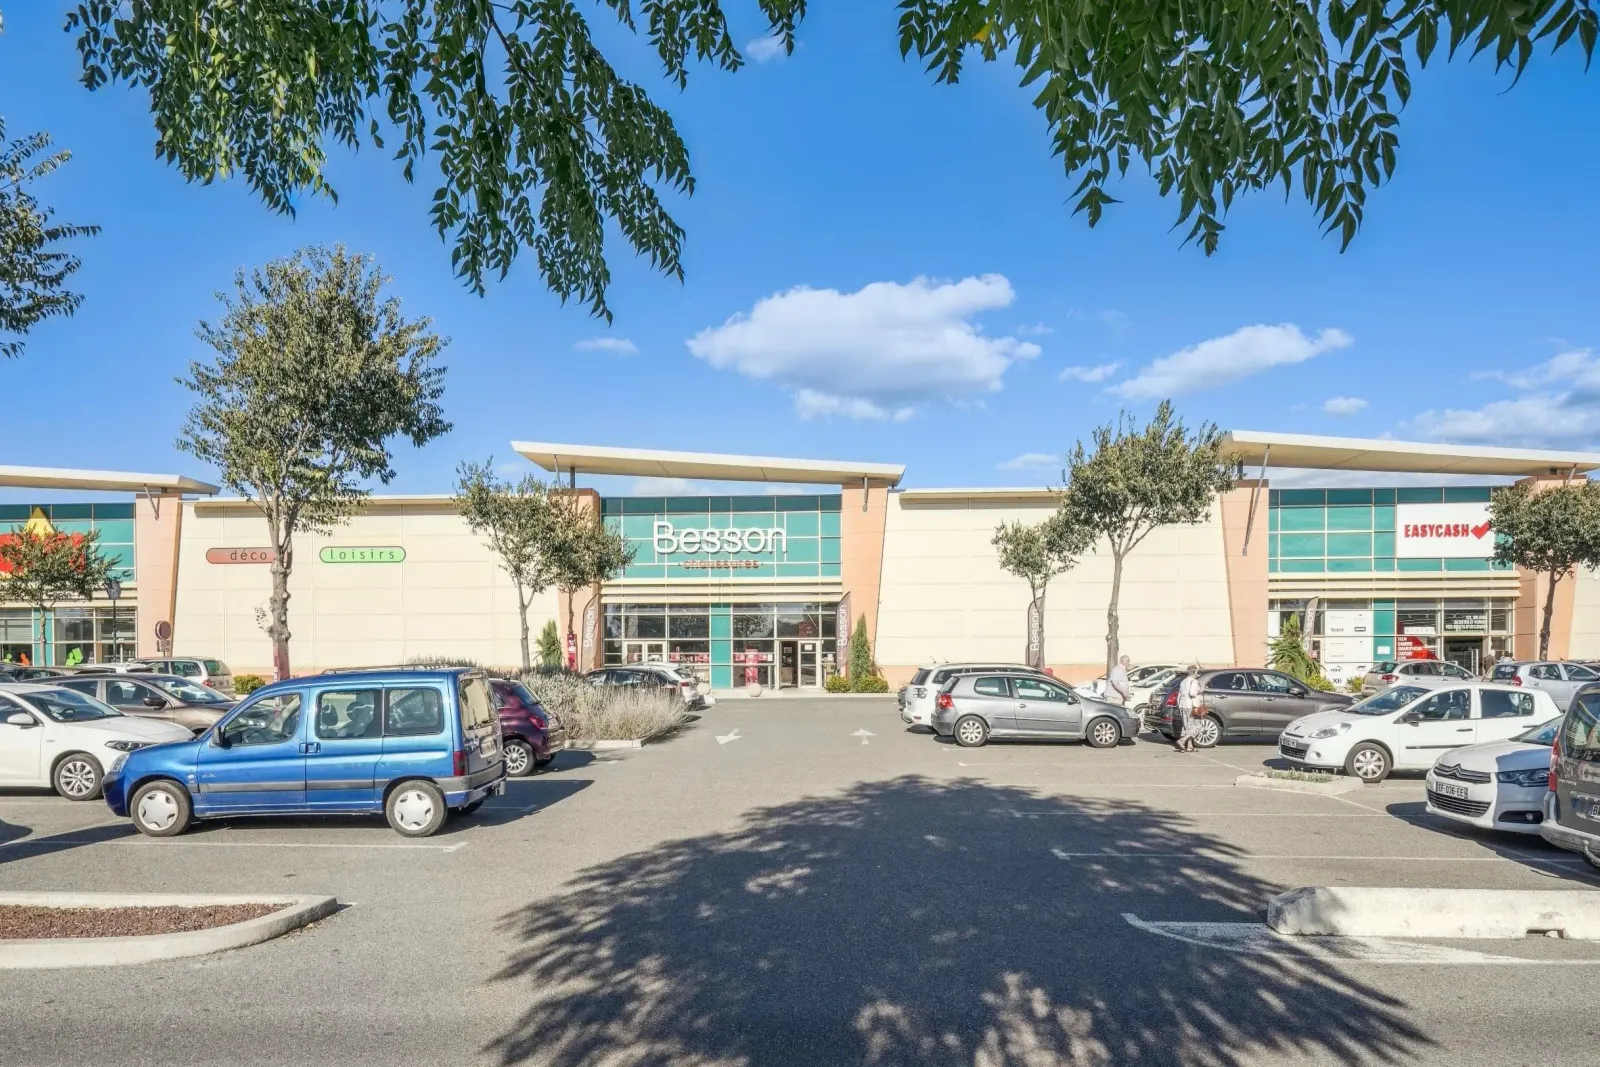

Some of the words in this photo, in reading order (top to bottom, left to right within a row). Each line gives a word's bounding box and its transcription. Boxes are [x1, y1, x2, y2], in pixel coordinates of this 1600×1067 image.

[653, 520, 787, 554] Besson
[1404, 524, 1470, 538] EASYCASH
[230, 548, 267, 561] déco
[330, 548, 395, 560] loisirs
[683, 559, 760, 569] chaussures
[584, 606, 595, 647] Besson
[838, 604, 848, 646] Besson
[1030, 608, 1040, 651] Besson
